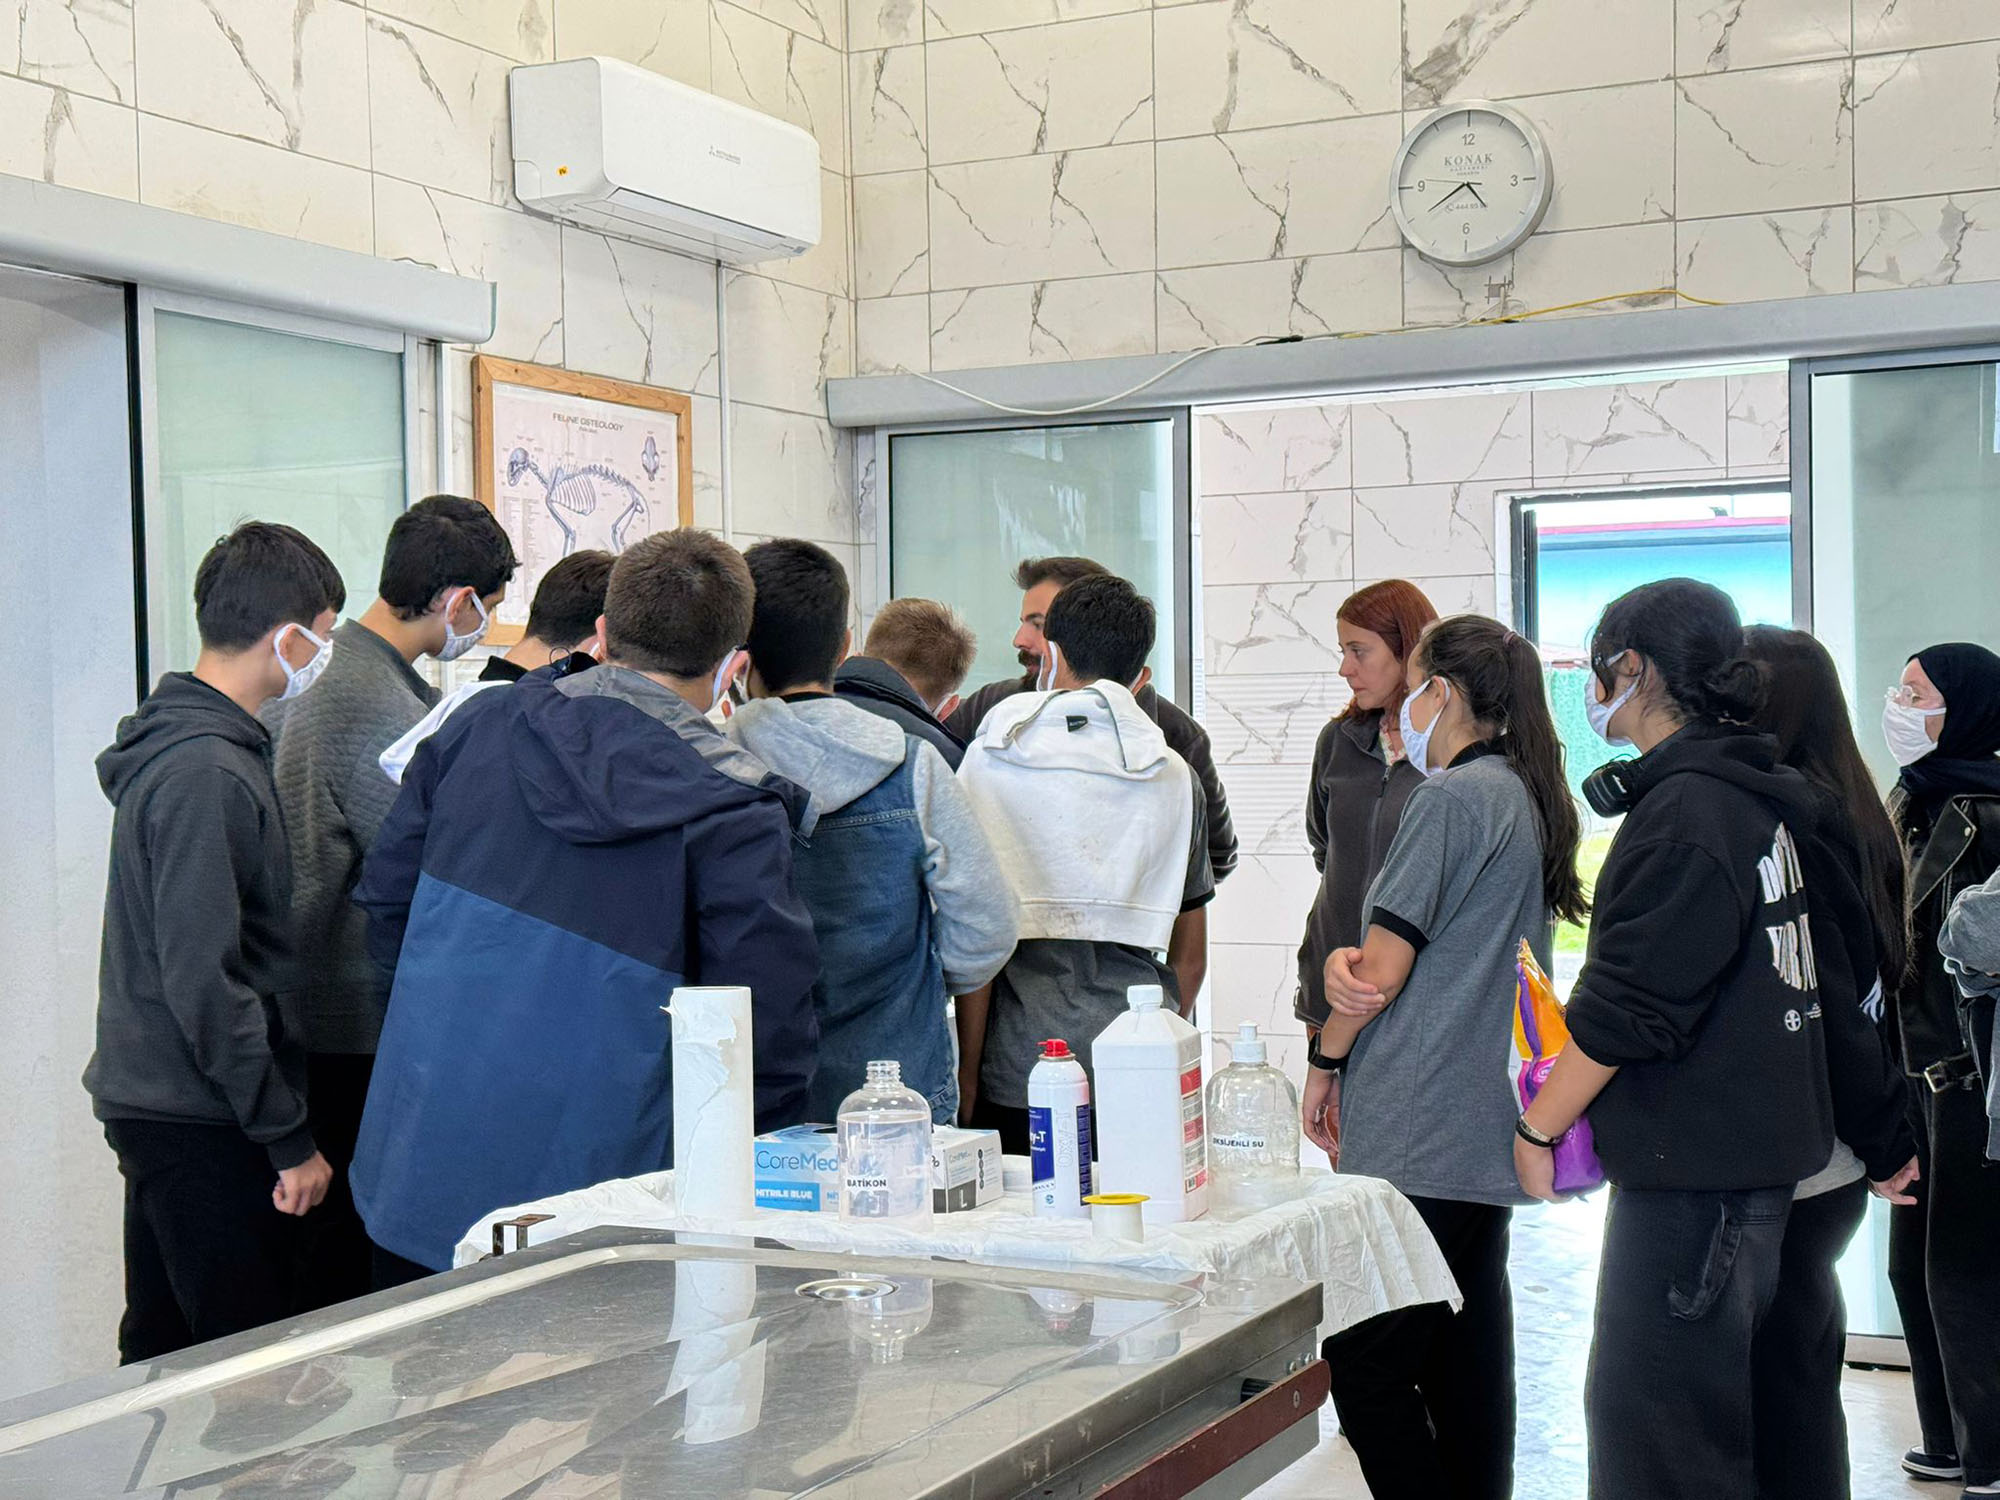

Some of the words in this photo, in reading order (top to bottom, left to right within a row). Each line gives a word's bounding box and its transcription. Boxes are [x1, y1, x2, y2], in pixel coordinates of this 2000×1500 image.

[1462, 133, 1475, 146] 12
[1444, 153, 1492, 166] KONAK
[1418, 180, 1426, 192] 9
[1510, 174, 1519, 187] 3
[1462, 222, 1470, 235] 6
[553, 412, 579, 424] FELINE
[580, 418, 624, 431] OSTEOLOGY
[1252, 1140, 1264, 1148] SU
[756, 1150, 839, 1171] CoreMed
[790, 1190, 813, 1200] BLUE
[960, 1189, 968, 1208] L
